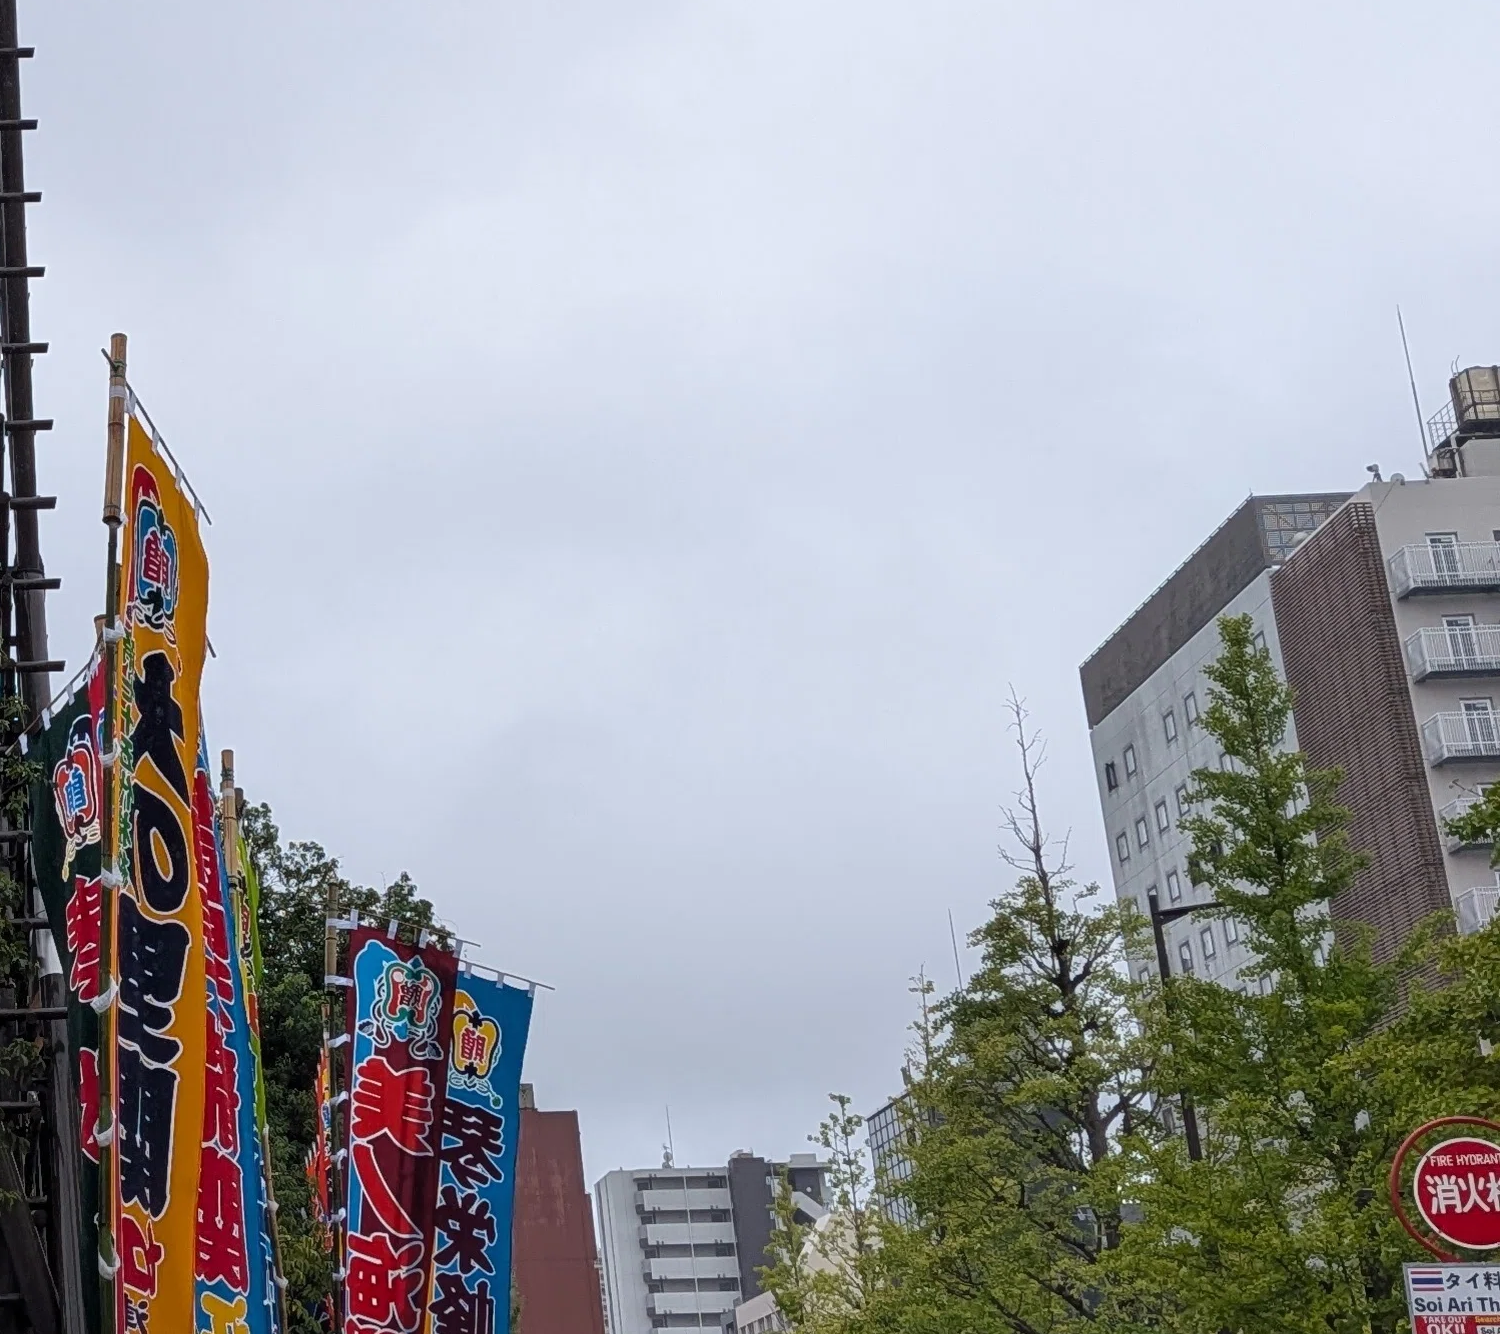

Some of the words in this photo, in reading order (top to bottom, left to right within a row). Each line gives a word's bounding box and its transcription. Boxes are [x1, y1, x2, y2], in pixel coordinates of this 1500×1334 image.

[1430, 1154, 1454, 1167] FIRE
[1414, 1297, 1444, 1313] Soi
[1448, 1296, 1474, 1313] Ari
[1422, 1315, 1446, 1325] TAKE
[1447, 1315, 1467, 1325] OUT
